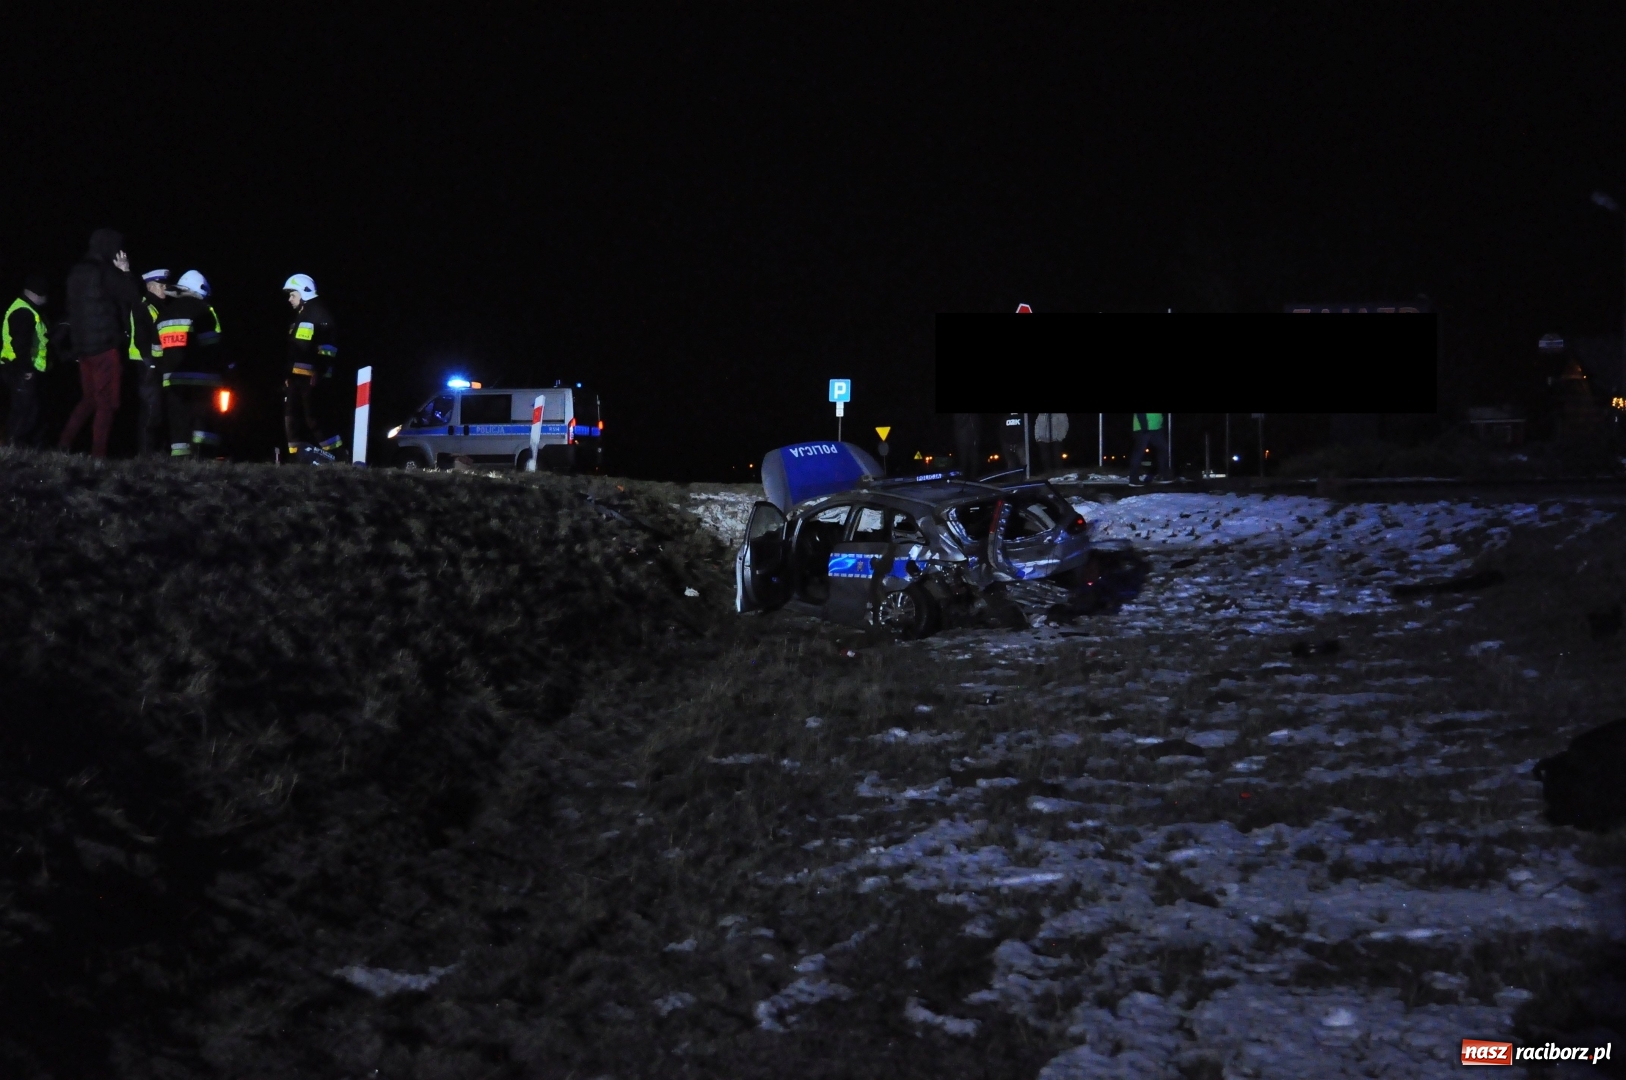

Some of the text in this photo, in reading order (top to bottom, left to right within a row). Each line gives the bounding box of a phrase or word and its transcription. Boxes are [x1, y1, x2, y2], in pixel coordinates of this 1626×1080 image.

[833, 381, 847, 400] P
[476, 426, 505, 434] POLICJA
[788, 443, 838, 458] POLICJA
